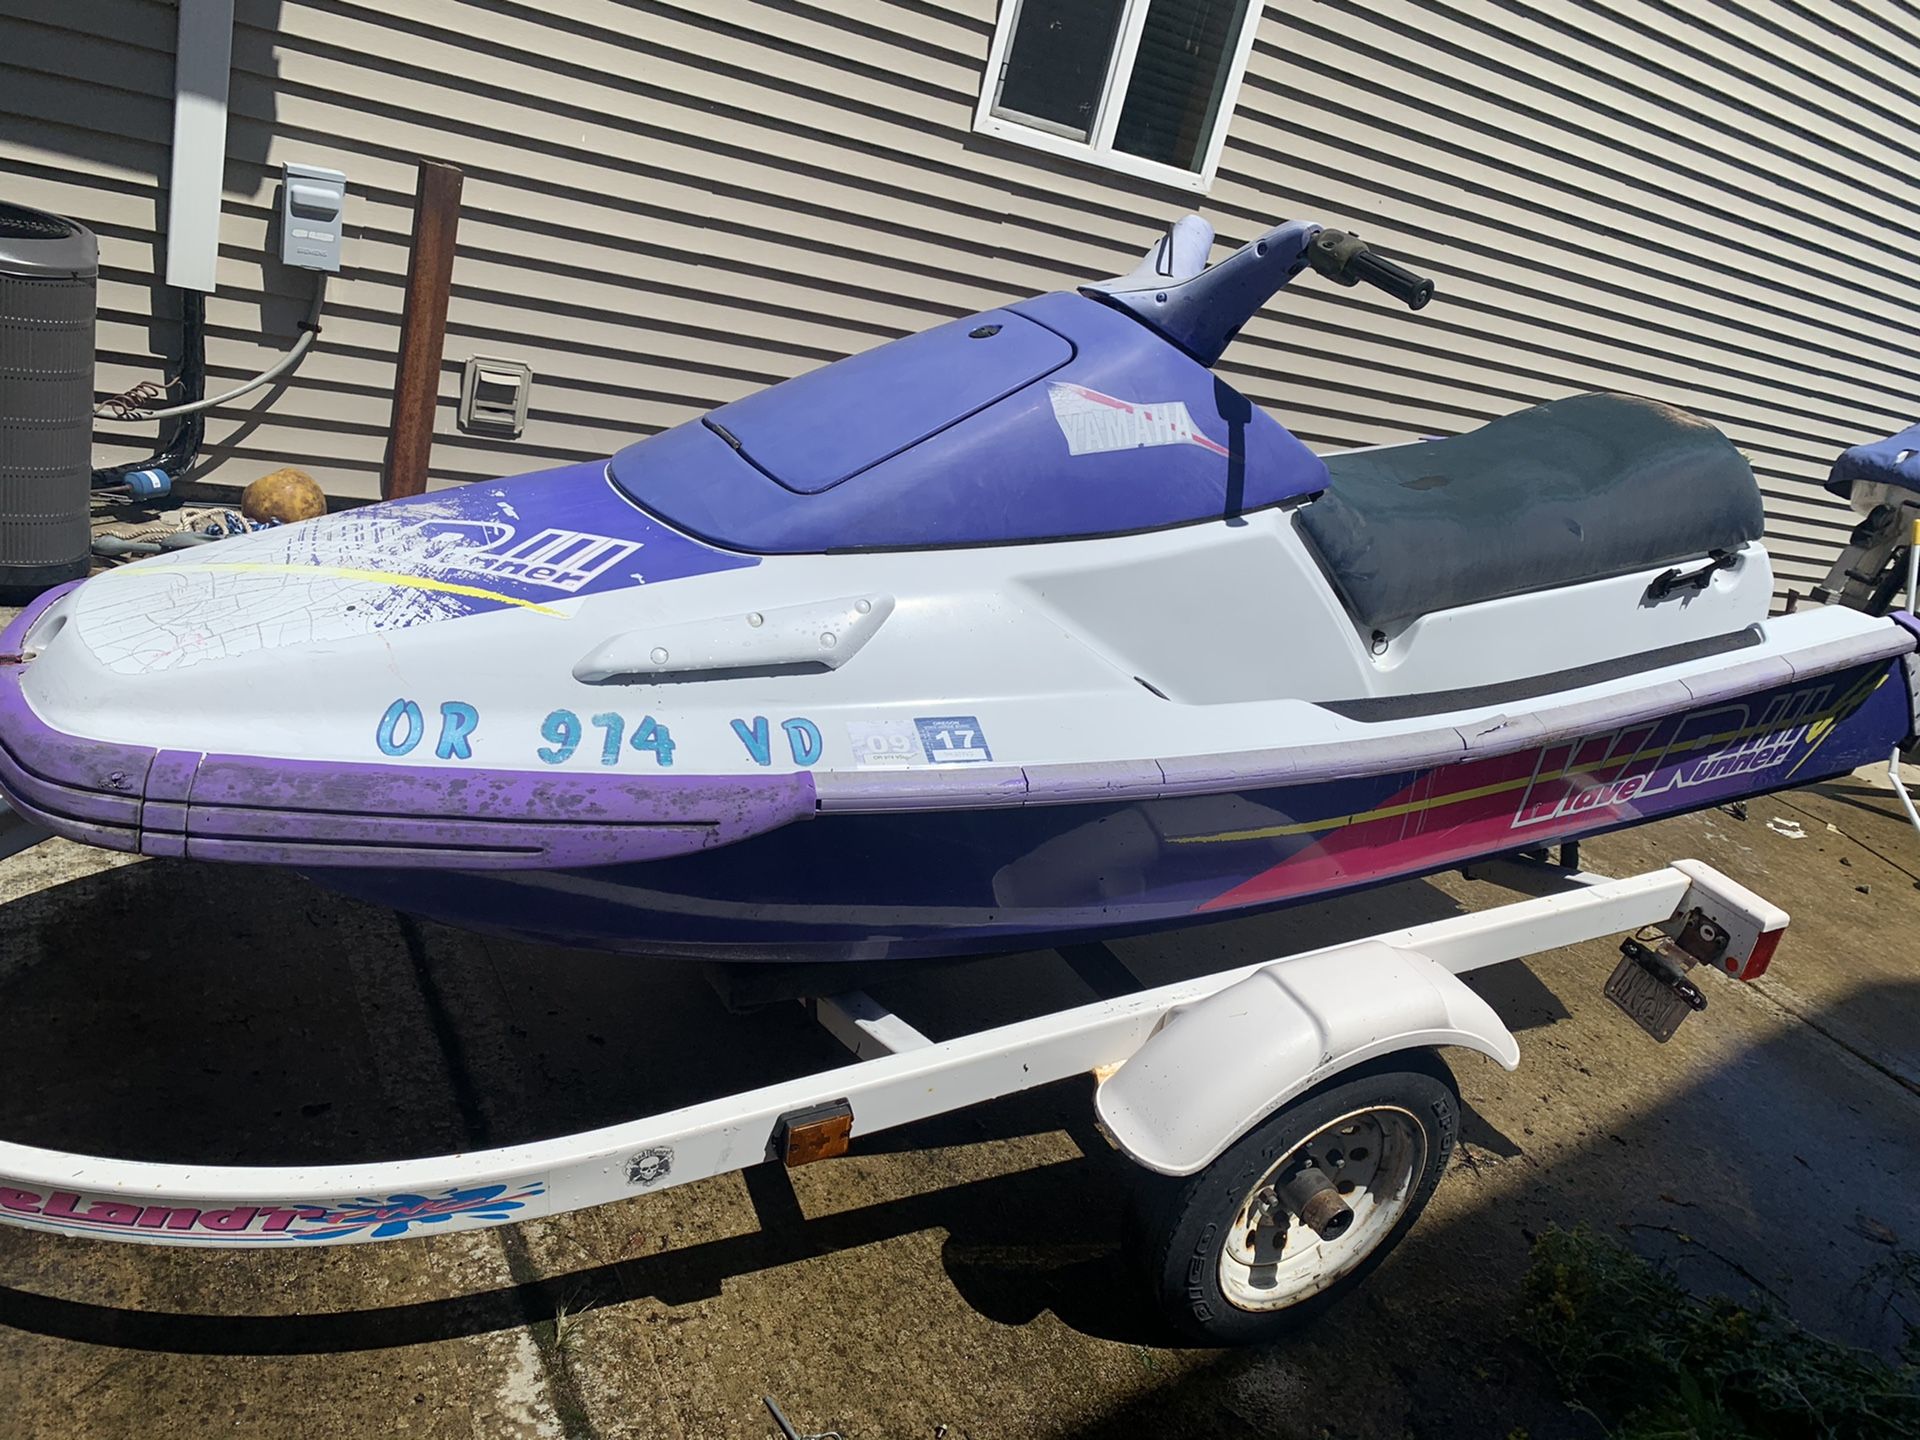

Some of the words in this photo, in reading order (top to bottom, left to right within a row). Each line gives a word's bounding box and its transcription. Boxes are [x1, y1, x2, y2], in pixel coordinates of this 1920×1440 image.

[1060, 403, 1191, 450] YAMAHA
[376, 698, 480, 760] OR
[537, 708, 676, 767] 974
[730, 716, 823, 766] VD
[866, 735, 911, 753] 09
[935, 730, 975, 749] 17
